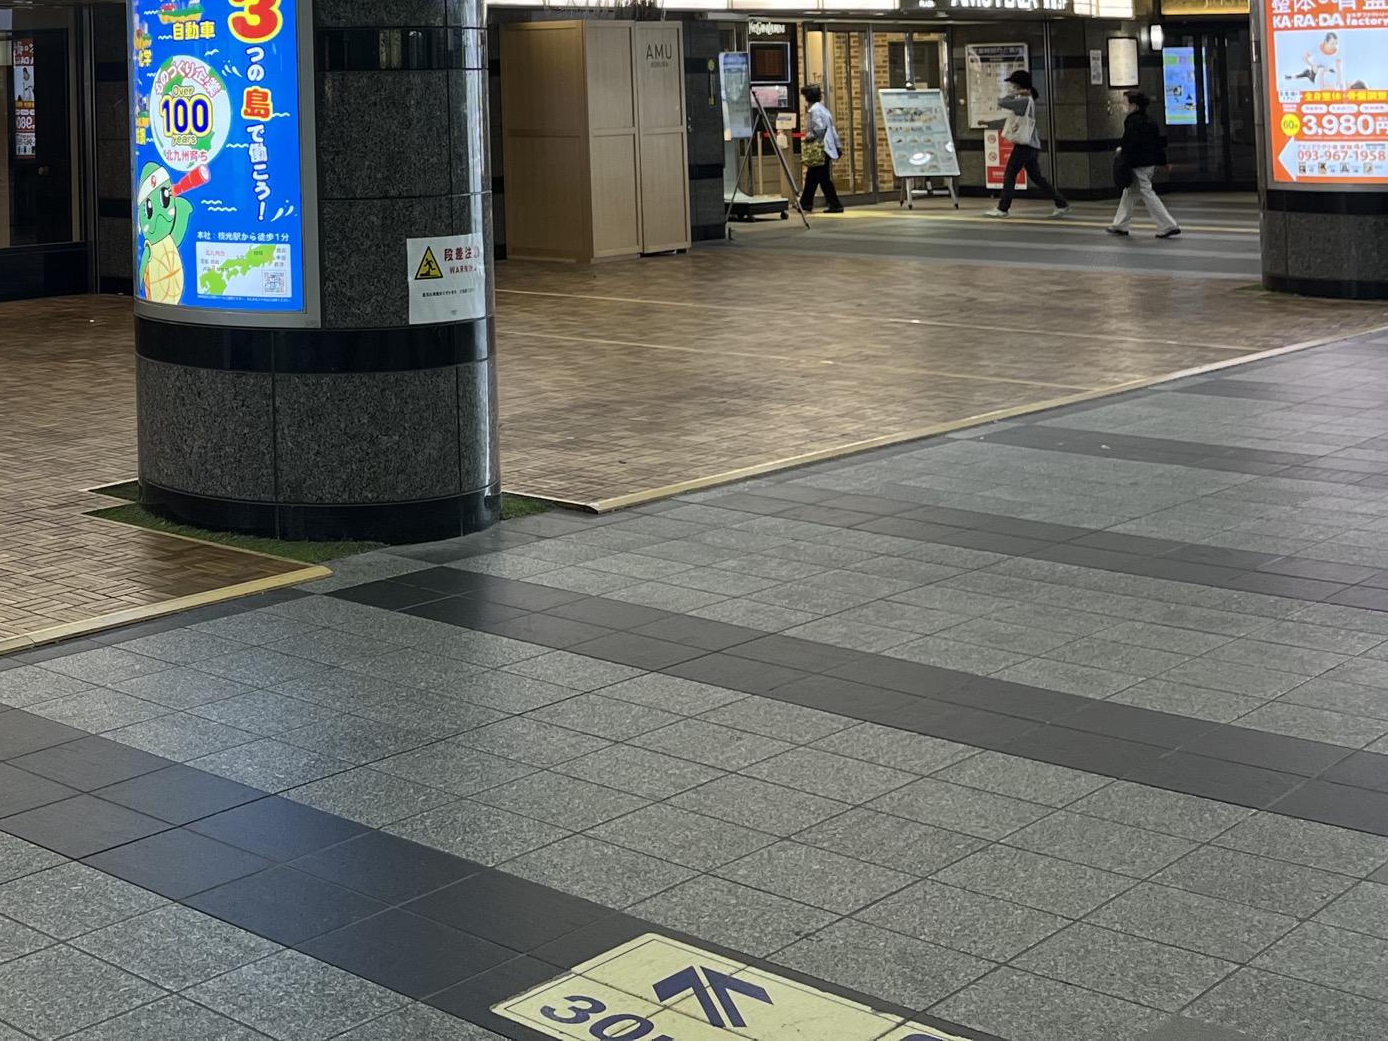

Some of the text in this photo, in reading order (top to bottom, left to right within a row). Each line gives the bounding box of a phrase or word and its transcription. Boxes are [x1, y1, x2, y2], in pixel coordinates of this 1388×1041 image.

[173, 20, 215, 41] 自動車
[646, 44, 672, 60] AMU
[154, 60, 222, 97] ものづくり企業
[172, 85, 195, 97] Over
[159, 93, 212, 136] 100
[171, 134, 198, 146] years
[166, 150, 208, 162] 北九州育ち
[1297, 150, 1386, 161] 093-967-1958
